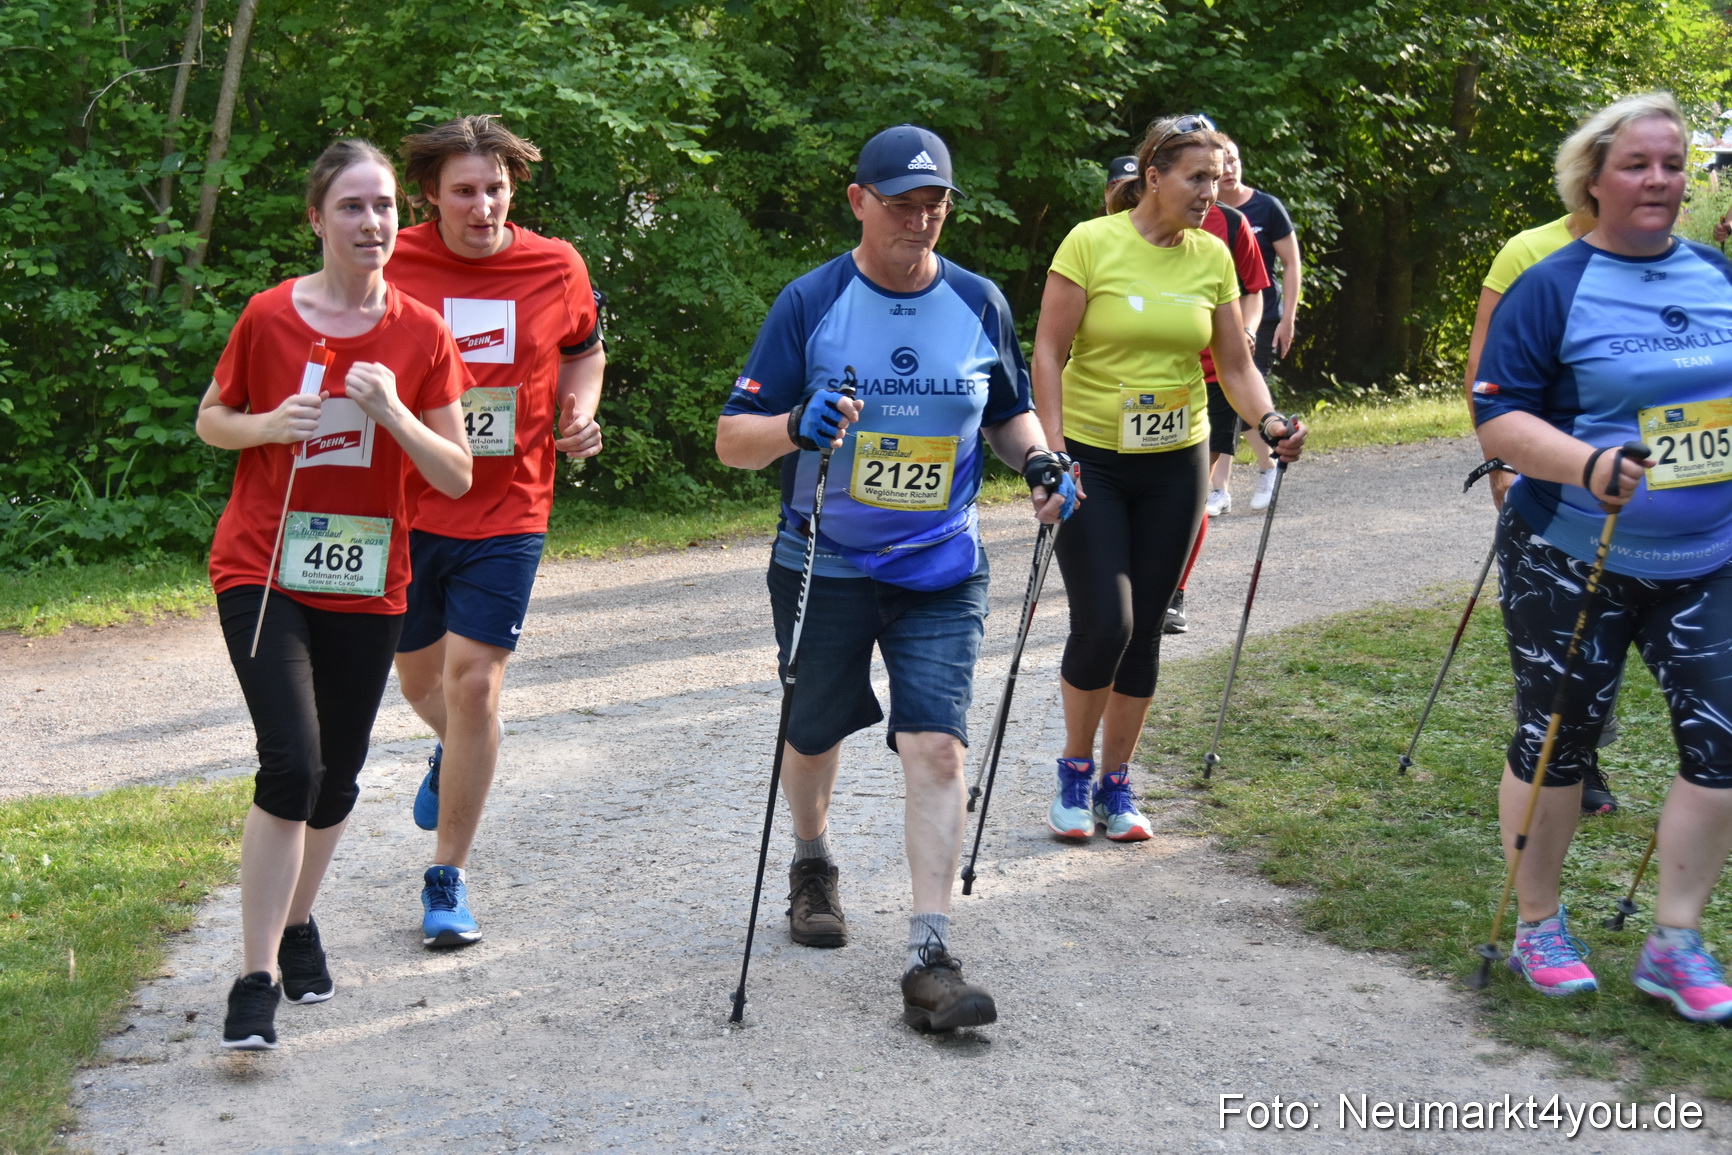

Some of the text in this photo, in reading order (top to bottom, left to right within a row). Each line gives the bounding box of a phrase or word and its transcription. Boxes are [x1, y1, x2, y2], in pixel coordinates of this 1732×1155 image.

[907, 162, 938, 171] adidas
[467, 335, 492, 348] DEHN
[1672, 355, 1714, 368] TEAM
[881, 404, 920, 416] TEAM
[1130, 408, 1184, 436] 1241
[319, 436, 346, 450] DEHN
[1656, 428, 1731, 466] 2105
[871, 446, 913, 459] firmenlauf
[1673, 460, 1724, 473] Brauner Petra
[863, 460, 942, 490] 2125
[865, 487, 938, 498] Weglöhner Richard
[300, 527, 343, 539] firmenlauf
[364, 537, 384, 546] 2019
[304, 542, 364, 572] 468
[302, 570, 364, 582] Bohlmann Katja
